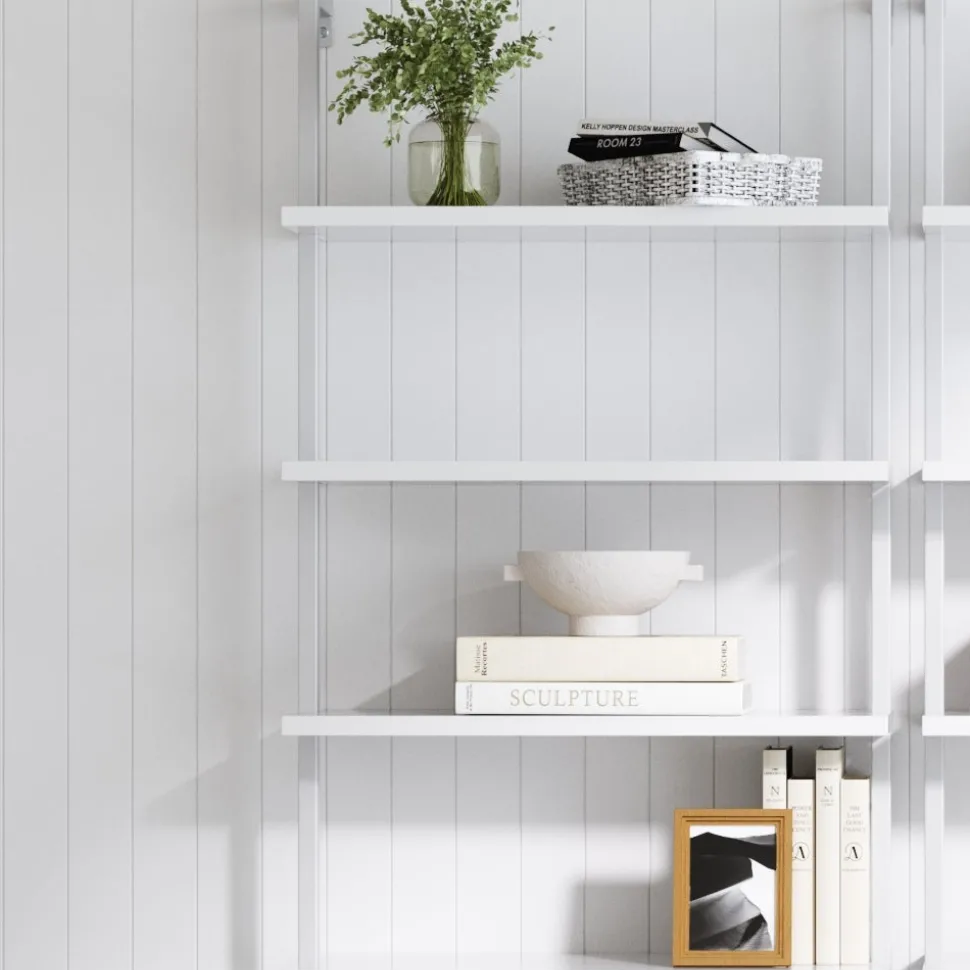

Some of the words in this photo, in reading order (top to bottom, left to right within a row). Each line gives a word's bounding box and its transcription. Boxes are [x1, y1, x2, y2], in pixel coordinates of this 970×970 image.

[581, 123, 600, 131] KELLY
[628, 124, 651, 132] DESIGN
[652, 126, 699, 134] MASTERCLASS
[596, 139, 628, 149] ROOM
[629, 137, 642, 147] 23
[509, 688, 640, 709] SCULPTURE
